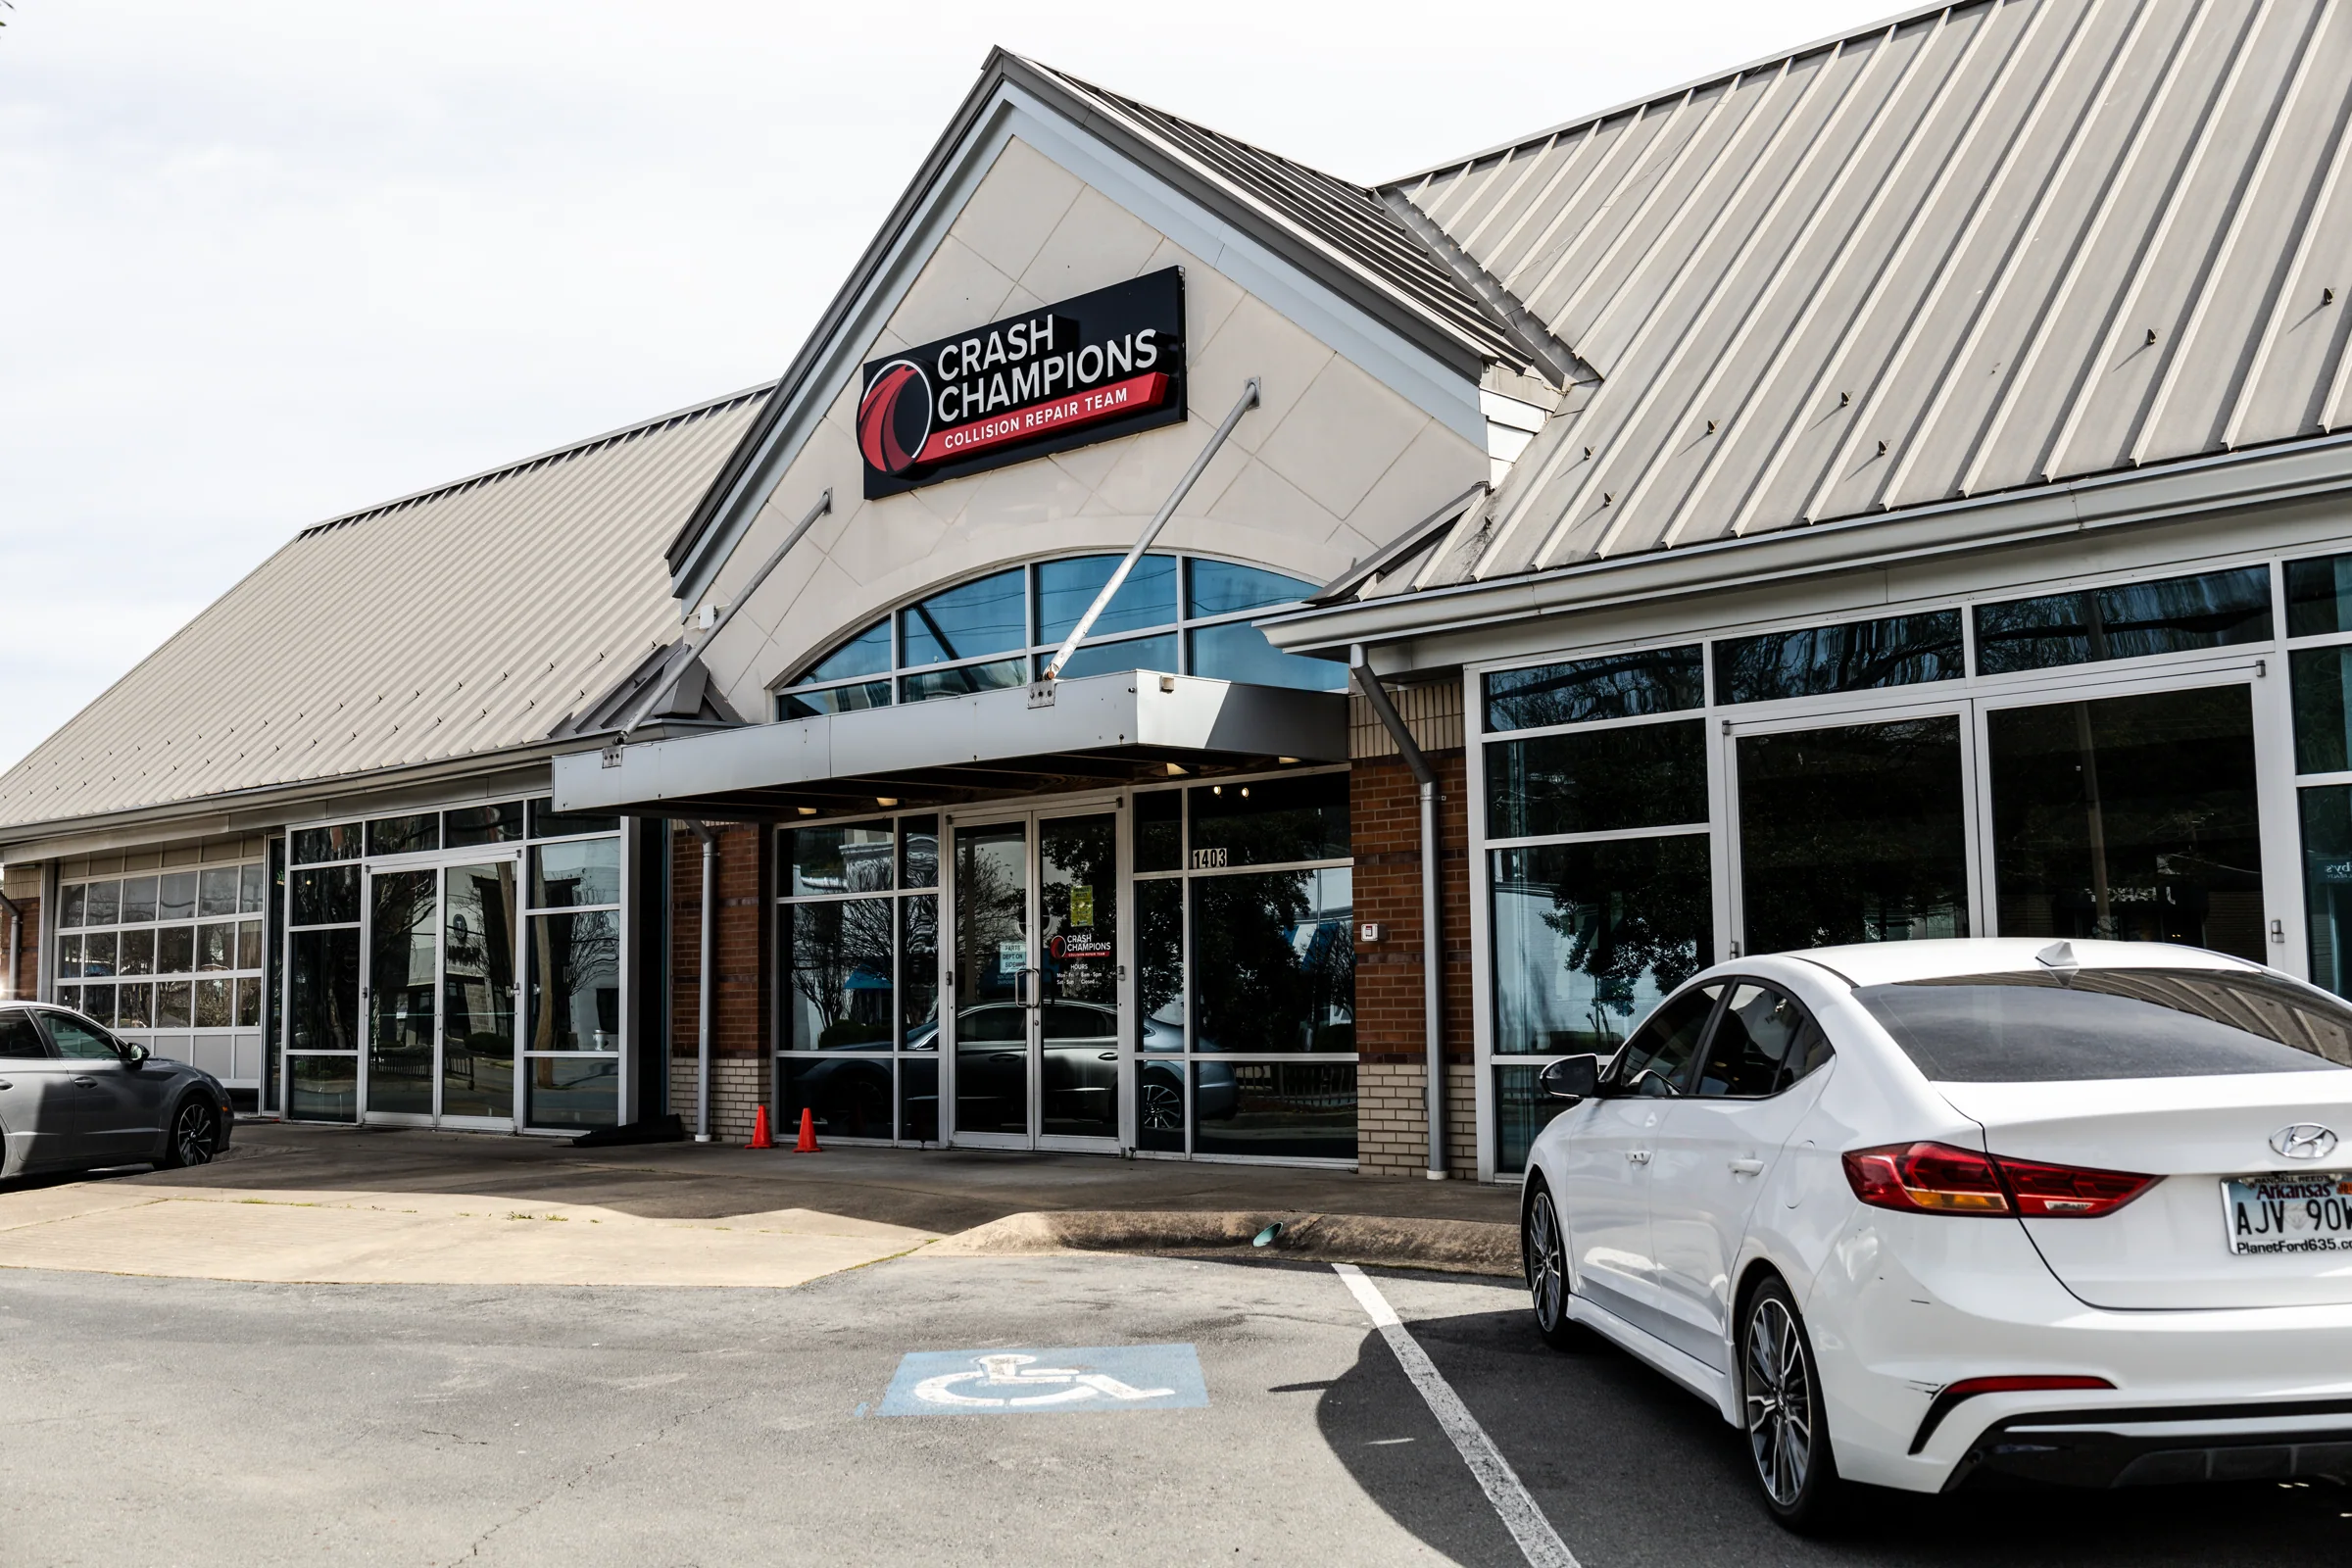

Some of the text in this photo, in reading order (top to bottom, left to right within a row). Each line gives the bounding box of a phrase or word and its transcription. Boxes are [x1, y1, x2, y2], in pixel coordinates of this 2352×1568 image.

[937, 314, 1054, 381] CRASH
[937, 328, 1158, 422] CHAMPIONS
[944, 388, 1128, 449] COLLISION REPAIR TEAM
[1195, 849, 1225, 868] 1403
[1067, 933, 1092, 943] CRASH
[1067, 942, 1111, 952] CHAMPIONS
[2256, 1184, 2331, 1200] Arkansas
[2236, 1200, 2285, 1236] AJV
[2236, 1238, 2352, 1254] PlanetFord635.co
